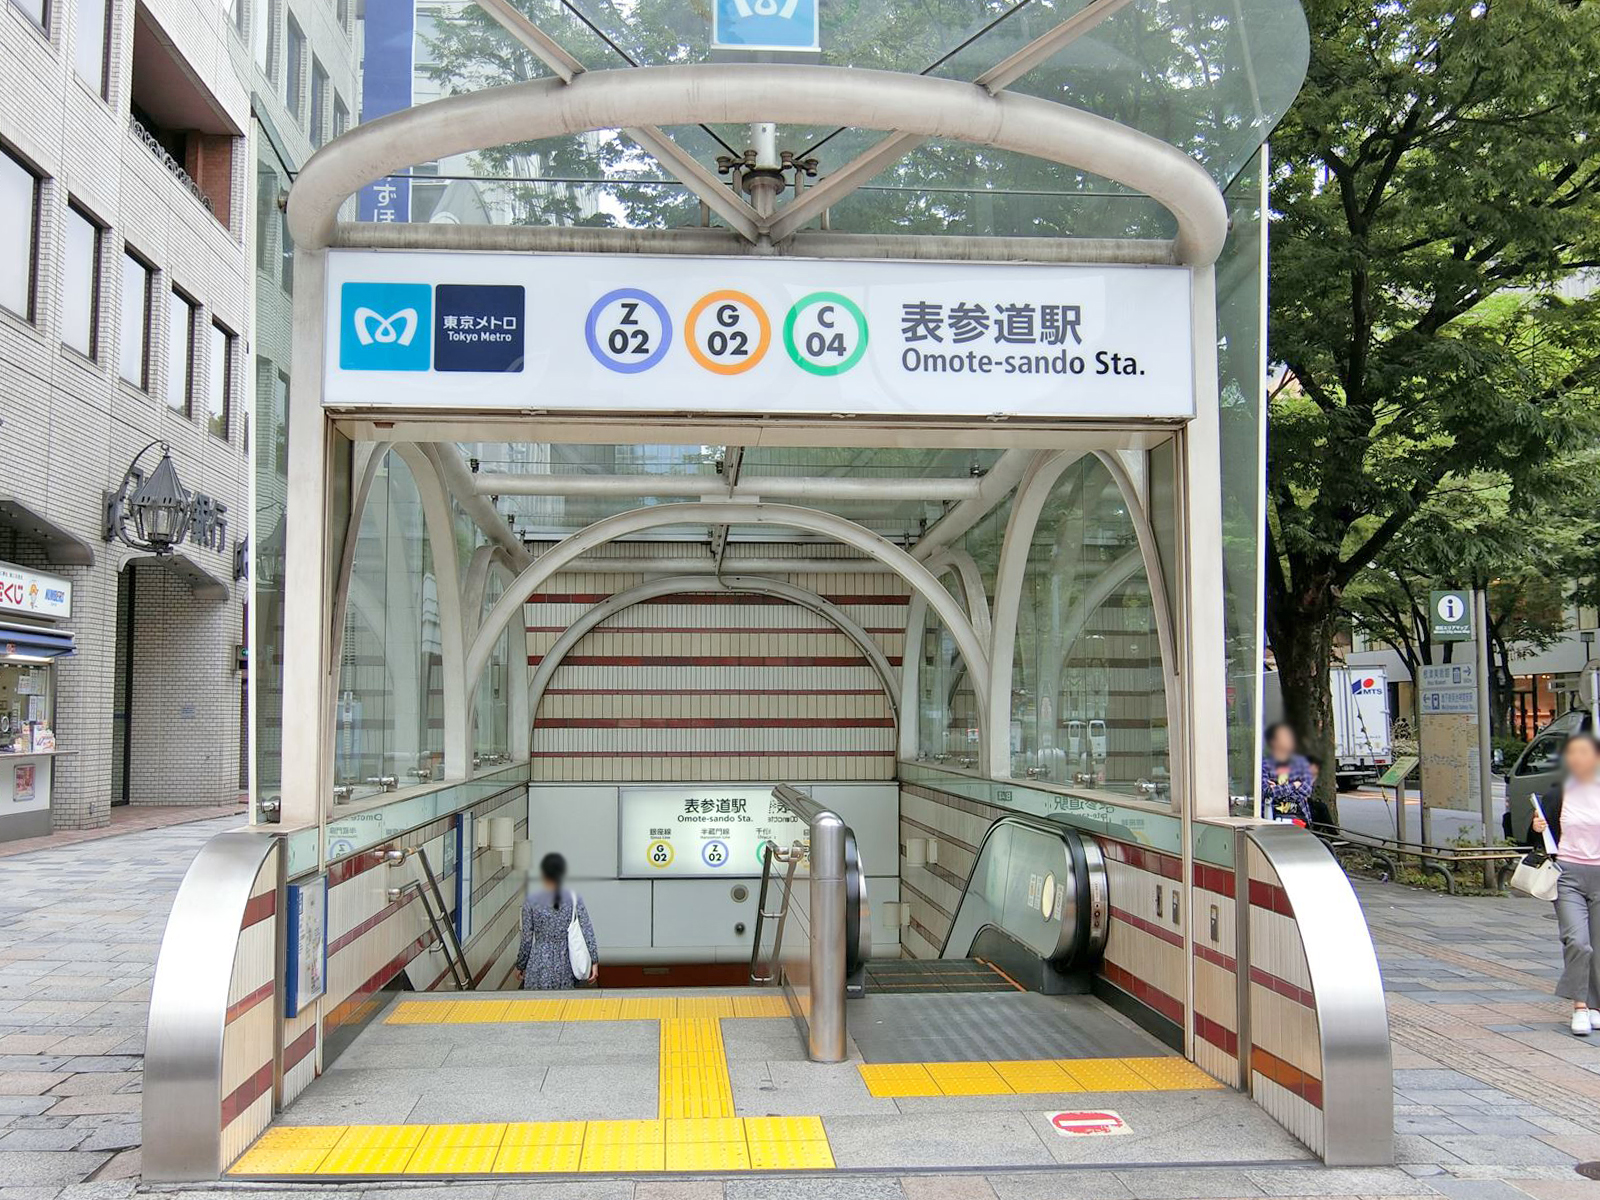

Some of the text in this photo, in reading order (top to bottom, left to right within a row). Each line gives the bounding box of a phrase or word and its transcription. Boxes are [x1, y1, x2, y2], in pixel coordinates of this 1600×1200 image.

[373, 177, 397, 222] ずほ
[443, 315, 517, 330] 東京メトロ
[620, 303, 639, 325] Z
[716, 304, 740, 327] G
[817, 306, 835, 328] C
[901, 301, 1083, 346] 表参道駅
[447, 331, 512, 343] Tokyo Metro
[608, 329, 650, 354] 02
[707, 331, 749, 356] 02
[806, 332, 847, 357] 04
[901, 347, 1145, 376] Omote-sando Sta.
[0, 582, 23, 604] くじ
[684, 798, 747, 814] 表参道駅
[677, 814, 754, 823] Omote-sando Sta.
[653, 853, 667, 862] 02
[656, 844, 664, 853] G
[708, 853, 722, 862] 02
[712, 844, 719, 852] Z
